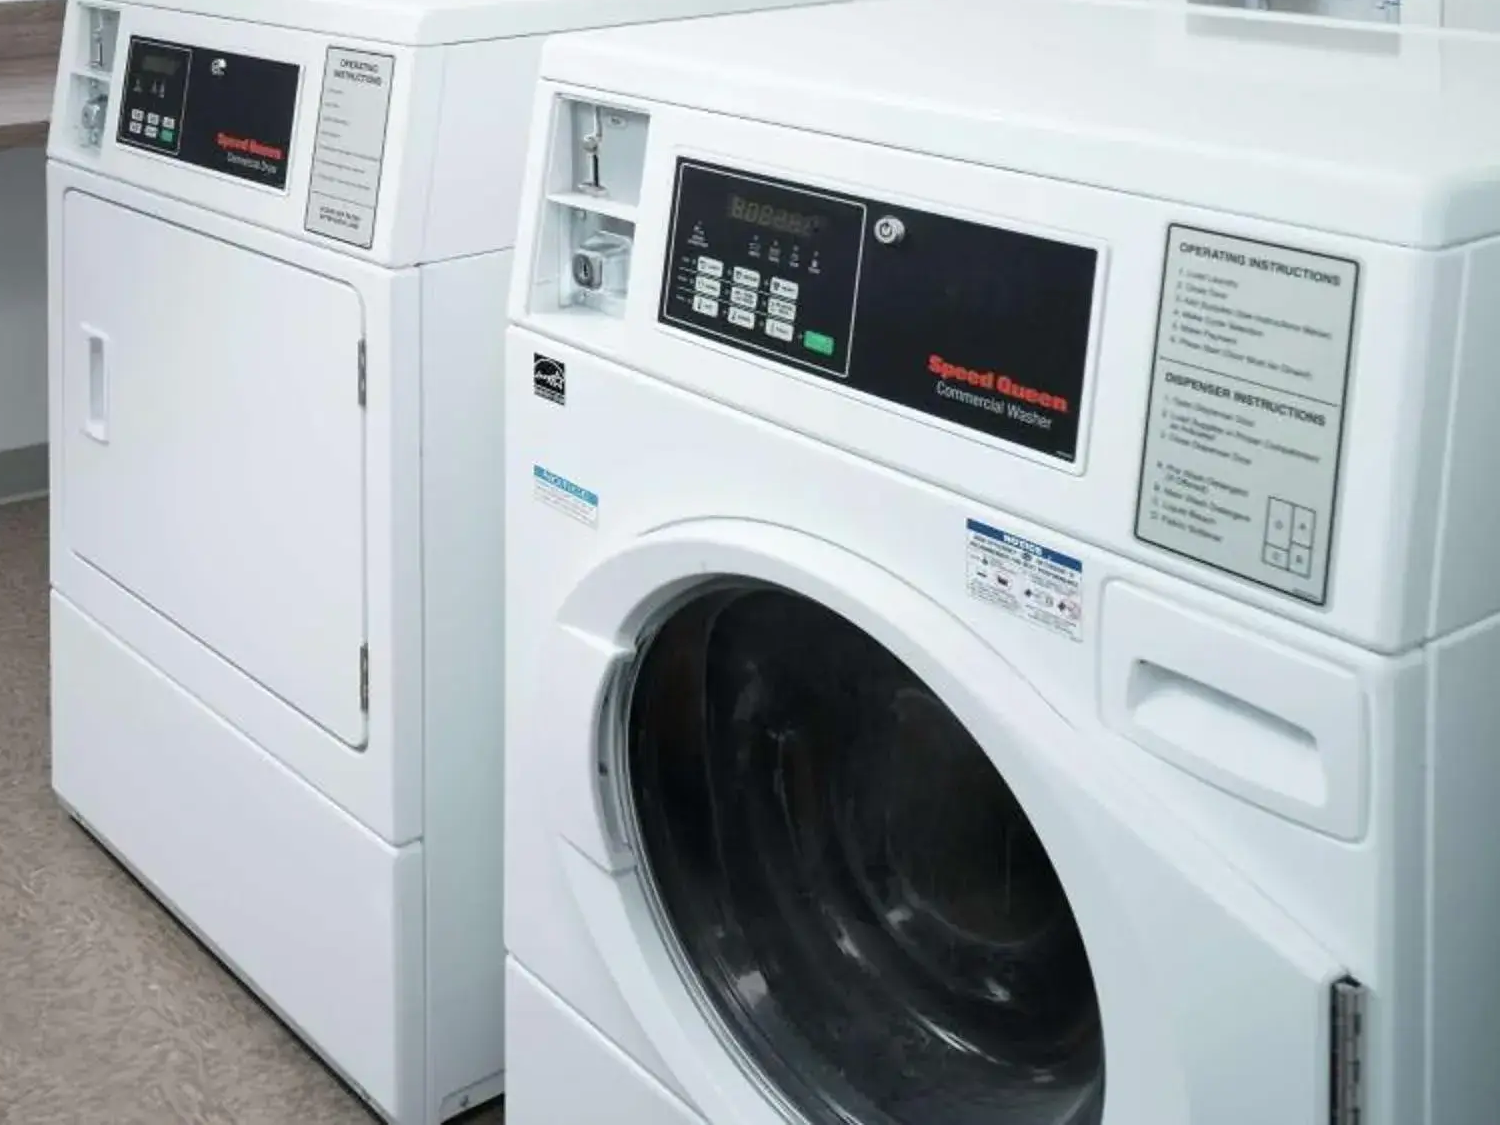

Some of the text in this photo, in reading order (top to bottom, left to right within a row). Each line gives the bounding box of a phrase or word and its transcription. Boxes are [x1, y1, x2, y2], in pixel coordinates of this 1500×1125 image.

[1180, 242, 1341, 286] OPERATING INSTRUCTIONS
[928, 354, 1069, 412] Speed Queen
[936, 380, 1052, 430] Commercial Washer
[1165, 372, 1231, 399] DISPENSER
[1234, 391, 1326, 426] INSTRUCTIONS
